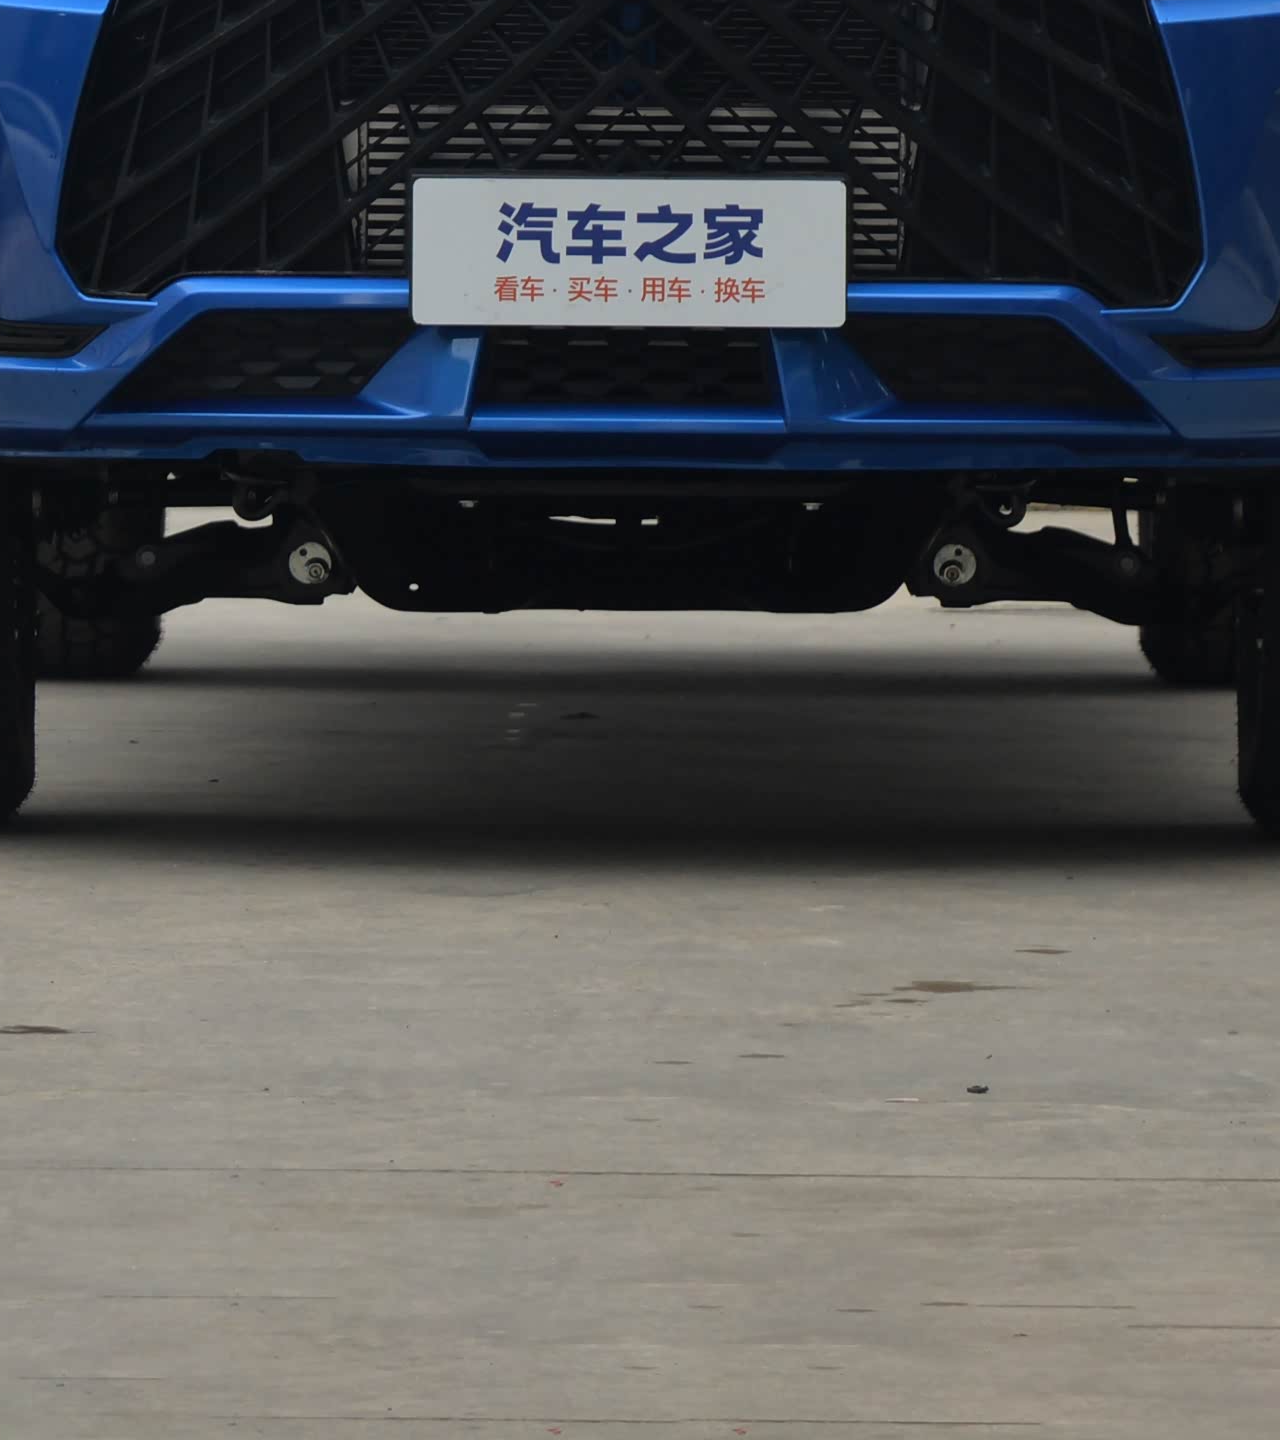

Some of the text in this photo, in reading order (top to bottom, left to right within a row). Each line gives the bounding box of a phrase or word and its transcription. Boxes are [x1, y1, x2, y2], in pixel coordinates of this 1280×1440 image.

[495, 201, 765, 265] 汽车之家
[494, 275, 766, 304] 看车 买车 用车 换车
